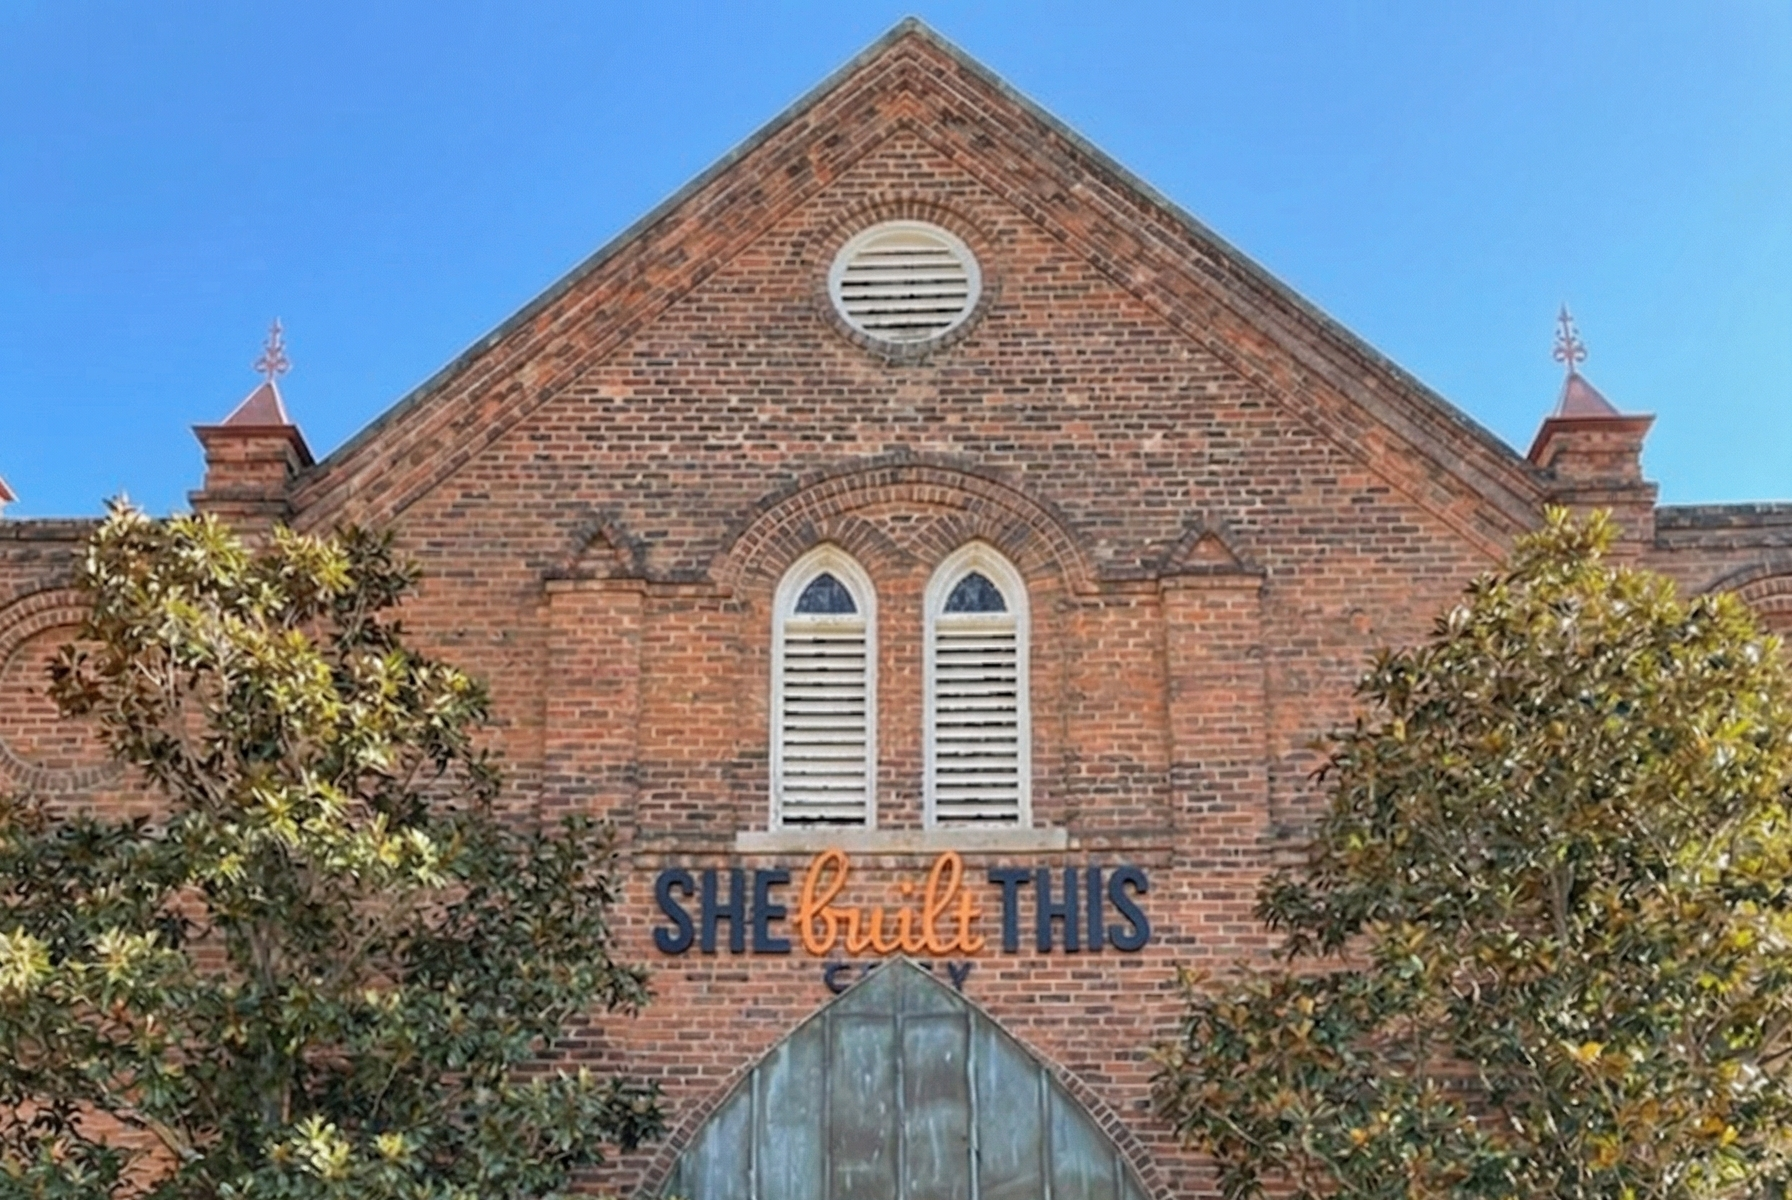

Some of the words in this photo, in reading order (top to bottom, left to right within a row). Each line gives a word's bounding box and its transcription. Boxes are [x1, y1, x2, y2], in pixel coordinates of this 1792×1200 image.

[653, 868, 791, 954] SHE
[795, 848, 984, 957] built
[987, 866, 1151, 953] THIS
[824, 960, 972, 996] CY
